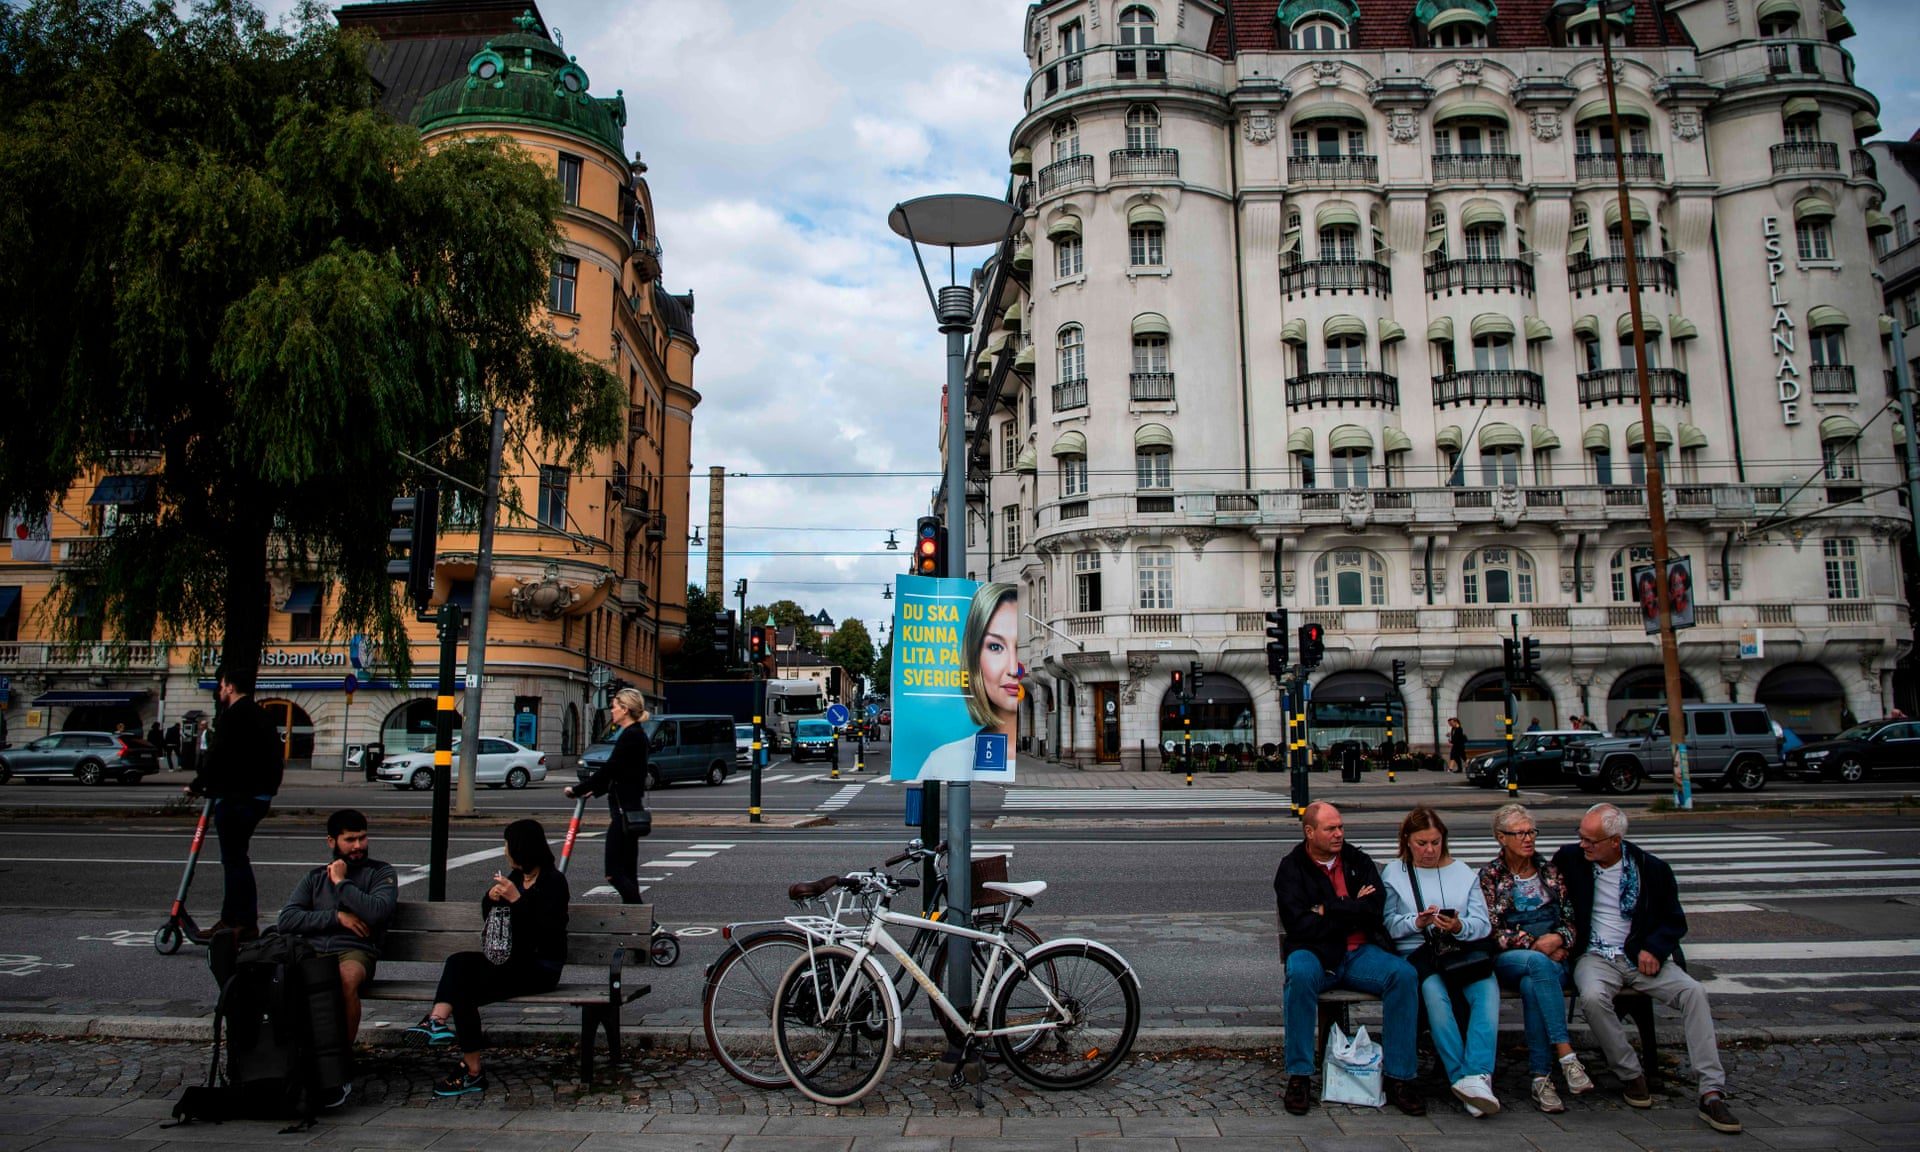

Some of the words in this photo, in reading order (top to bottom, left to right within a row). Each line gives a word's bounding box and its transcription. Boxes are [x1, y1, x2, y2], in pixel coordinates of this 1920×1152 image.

[1762, 215, 1801, 426] ESPLANADE
[903, 603, 923, 620] DU
[928, 605, 960, 622] SKA
[903, 625, 958, 643] KUNNA
[202, 648, 344, 666] Halsbanken
[903, 647, 935, 665] LITA
[940, 642, 960, 665] PÅ
[903, 669, 969, 688] SVERIGE
